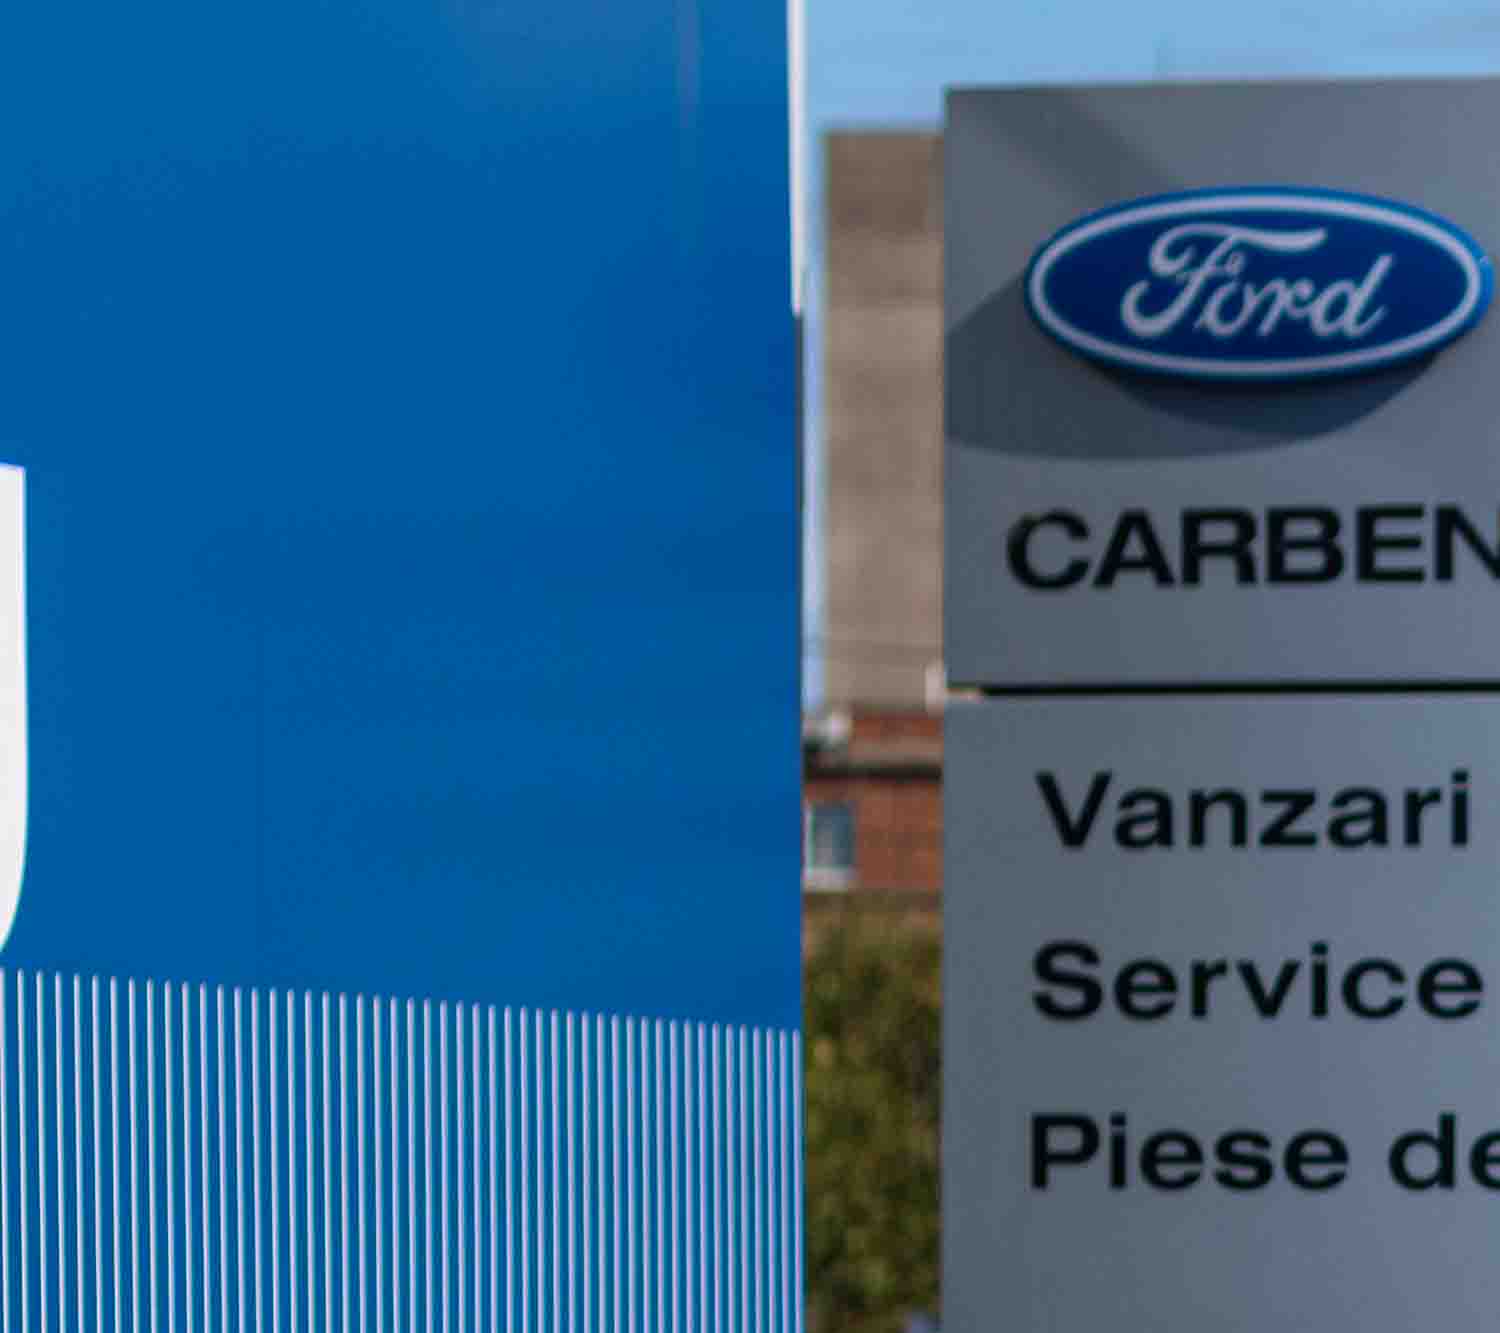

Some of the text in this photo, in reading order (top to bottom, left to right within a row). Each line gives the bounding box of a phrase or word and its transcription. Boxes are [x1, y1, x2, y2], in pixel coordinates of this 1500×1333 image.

[1121, 224, 1390, 340] Ford
[1034, 770, 1471, 851] Vanzari
[1031, 940, 1485, 1022] Service
[1031, 1113, 1350, 1193] Piese
